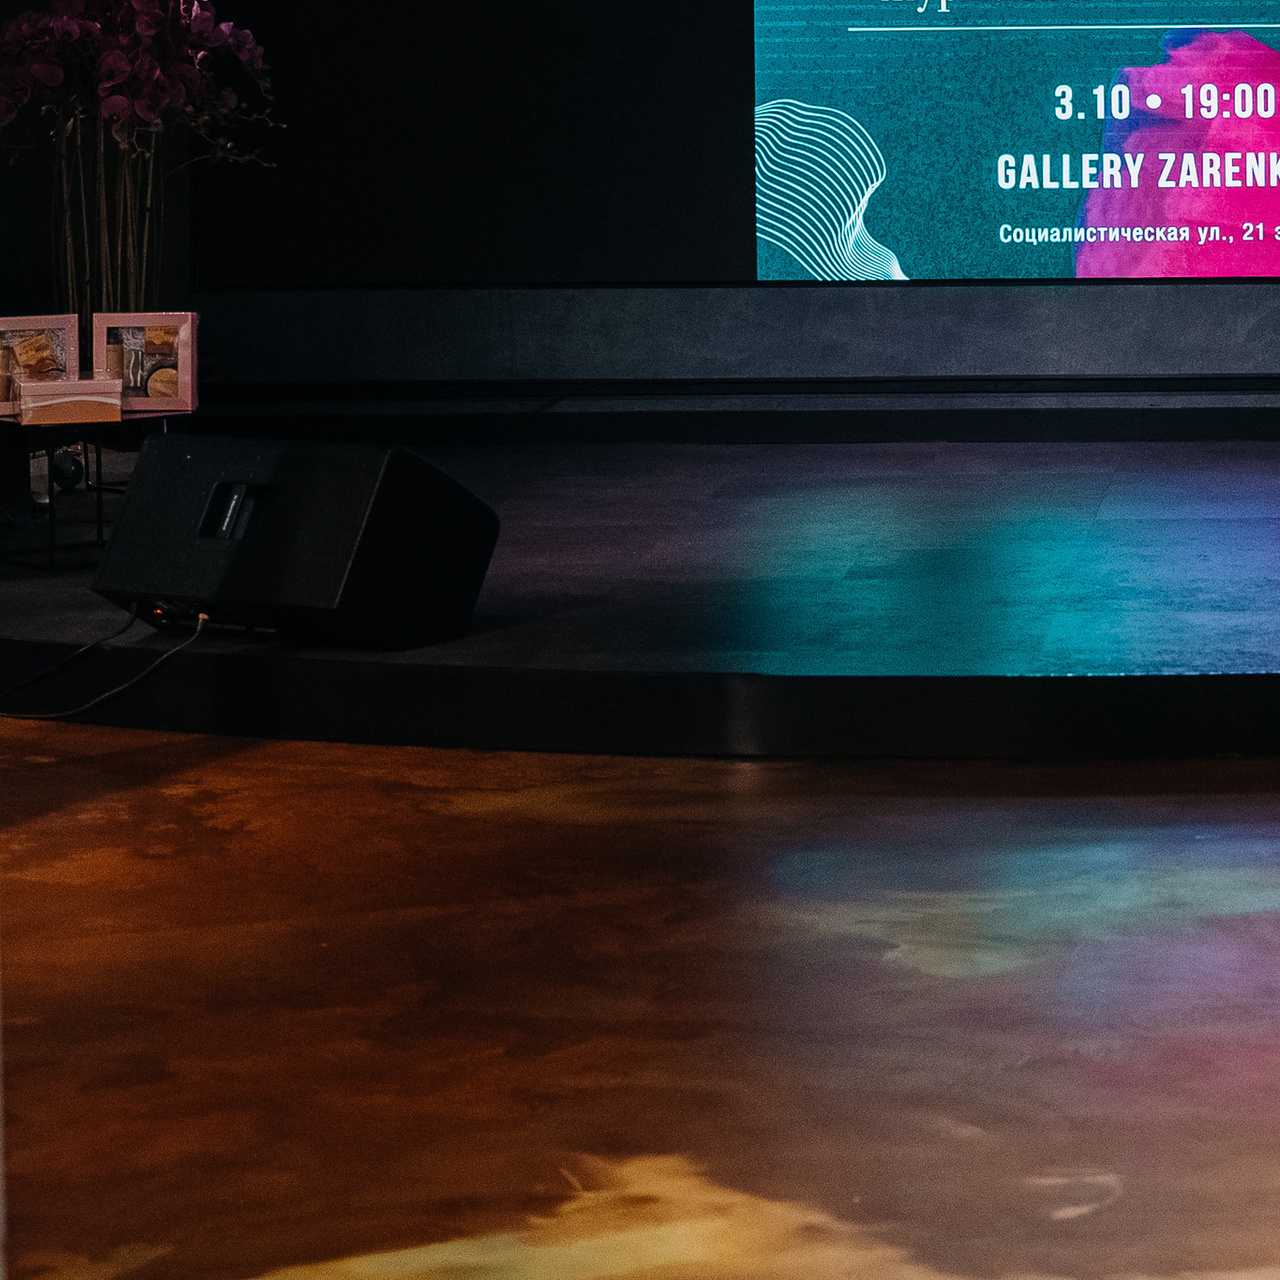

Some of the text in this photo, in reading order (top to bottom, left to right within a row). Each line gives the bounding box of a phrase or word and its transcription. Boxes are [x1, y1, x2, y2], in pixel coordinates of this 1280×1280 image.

[1053, 82, 1277, 121] 3.10 19:00
[997, 152, 1145, 190] GALLERY
[998, 223, 1190, 245] Социалистическая
[1197, 226, 1235, 245] ул.,
[1242, 222, 1265, 241] 21
